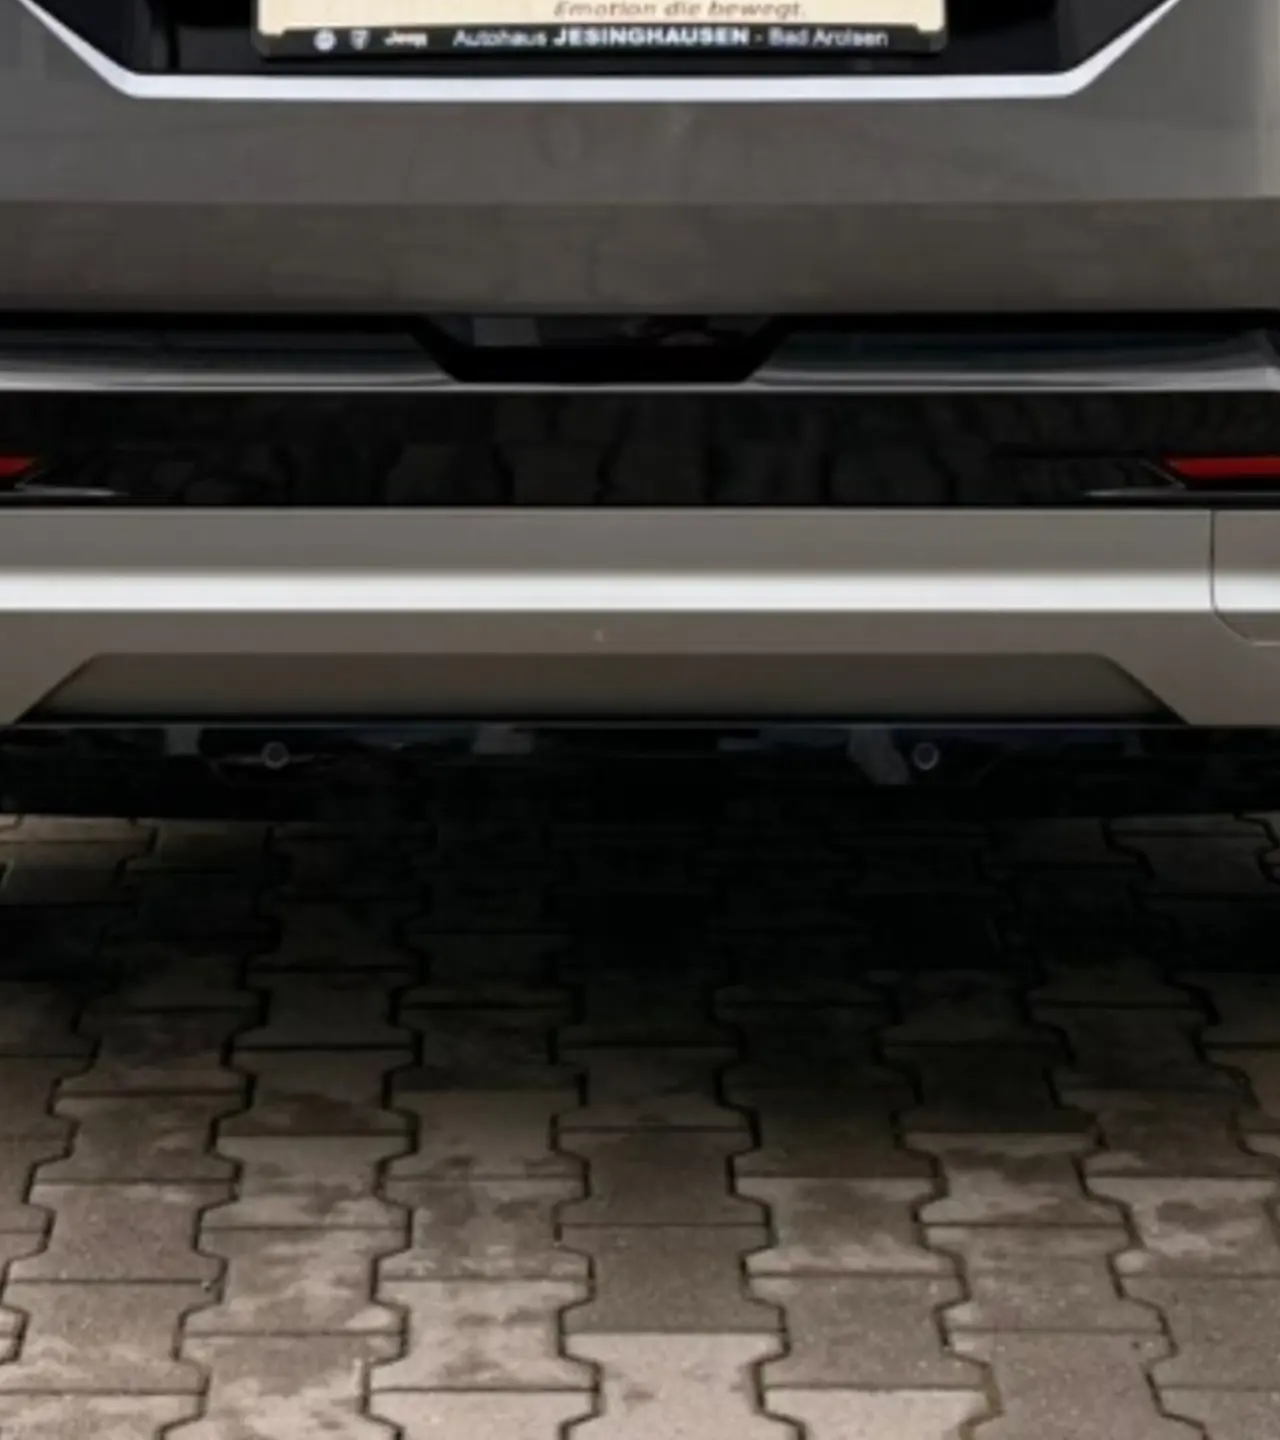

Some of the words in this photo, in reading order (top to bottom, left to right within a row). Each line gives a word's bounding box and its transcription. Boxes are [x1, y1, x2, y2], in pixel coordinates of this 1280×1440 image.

[553, 0, 656, 18] Emotion
[663, 0, 703, 18] die
[452, 29, 548, 48] Autohaus
[552, 26, 750, 47] JESINGHAUSEN
[768, 29, 809, 47] Bad
[812, 30, 890, 48] Arolsen
